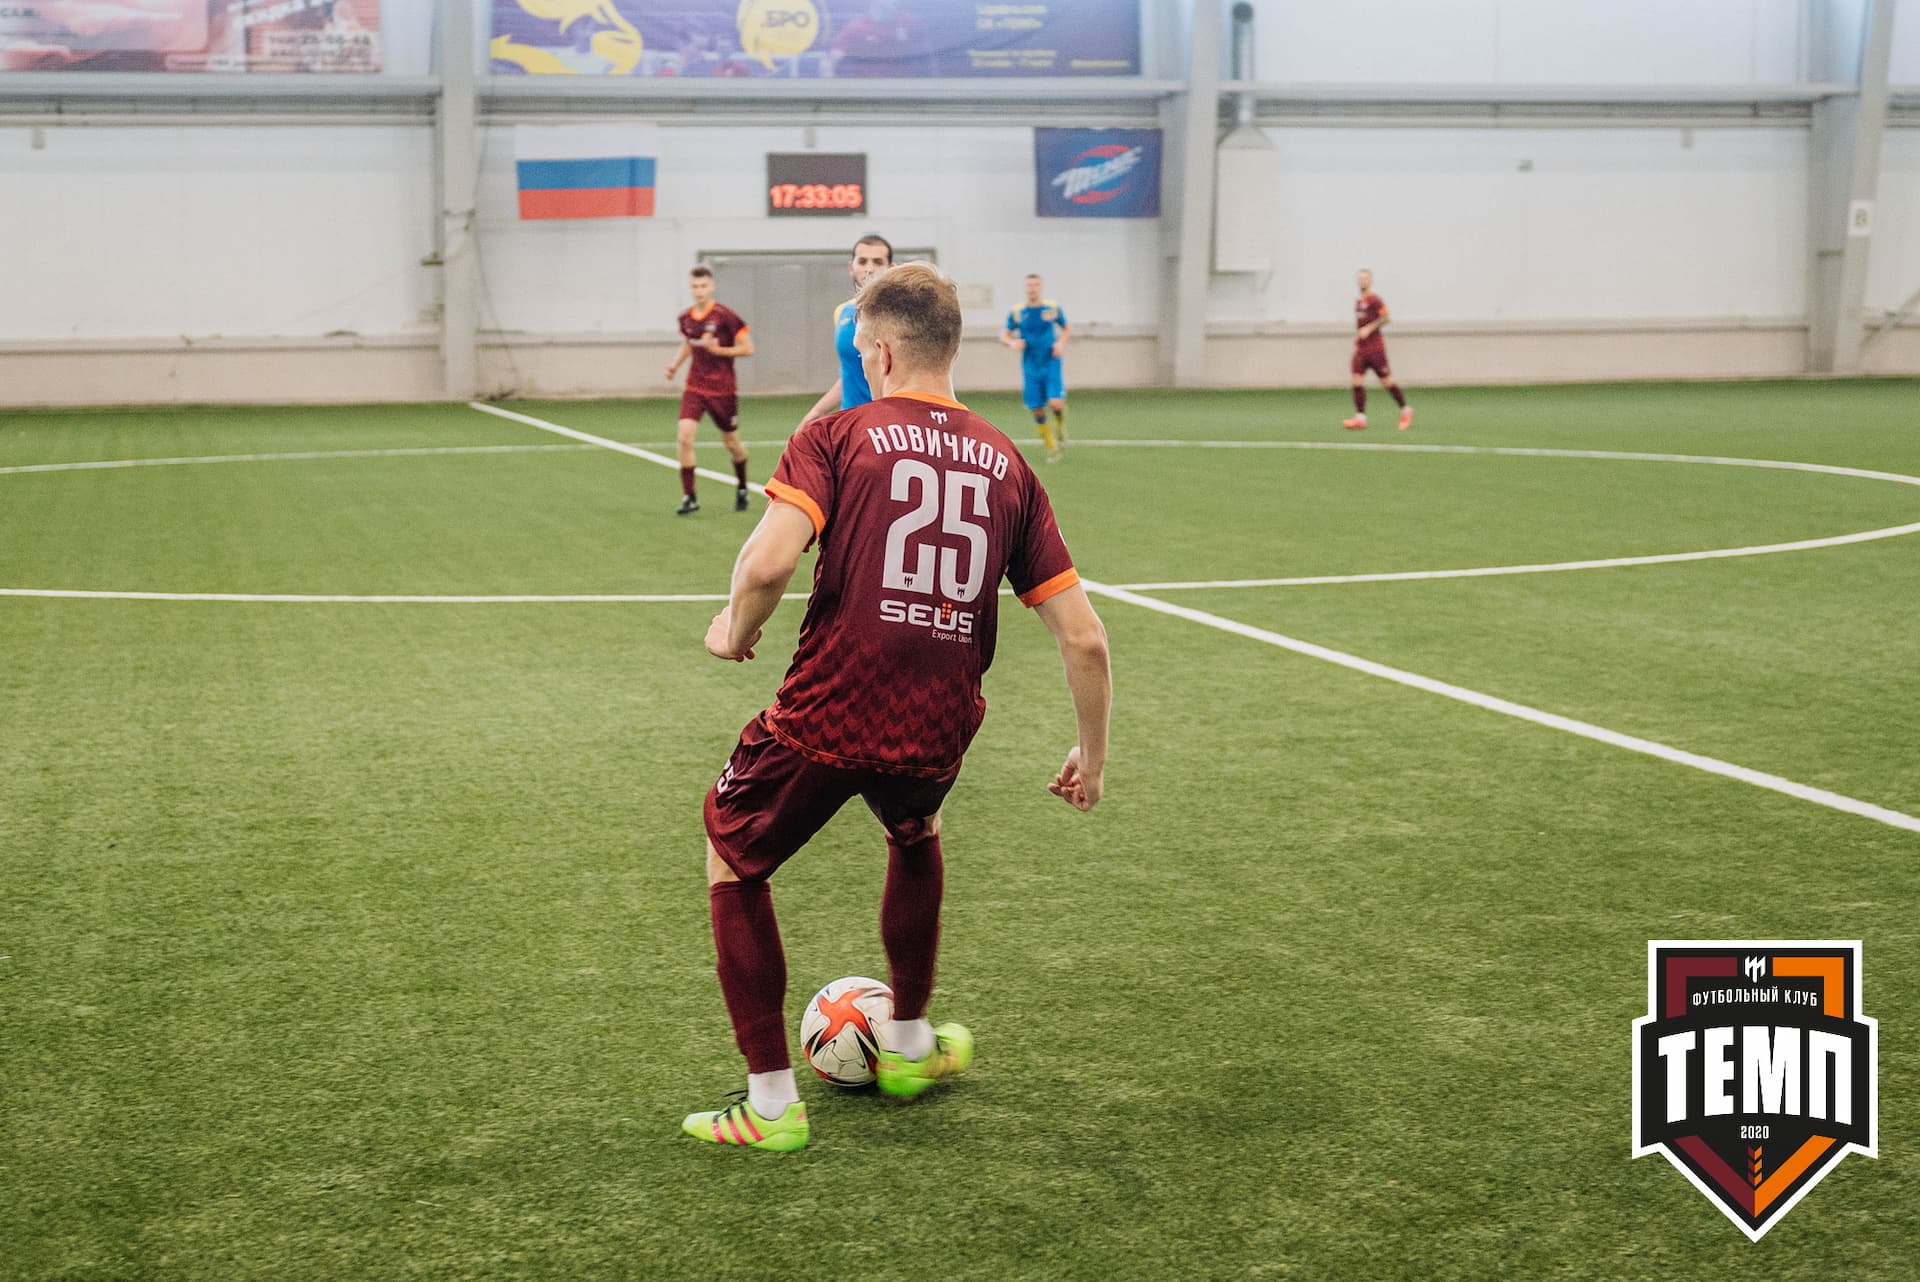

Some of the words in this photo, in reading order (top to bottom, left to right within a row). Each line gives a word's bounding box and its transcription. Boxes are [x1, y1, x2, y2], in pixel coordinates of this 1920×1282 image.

[769, 184, 863, 208] 17:33:05
[867, 424, 1009, 481] НОВИЧКОВ
[882, 458, 991, 603] 25
[932, 629, 957, 641] Export
